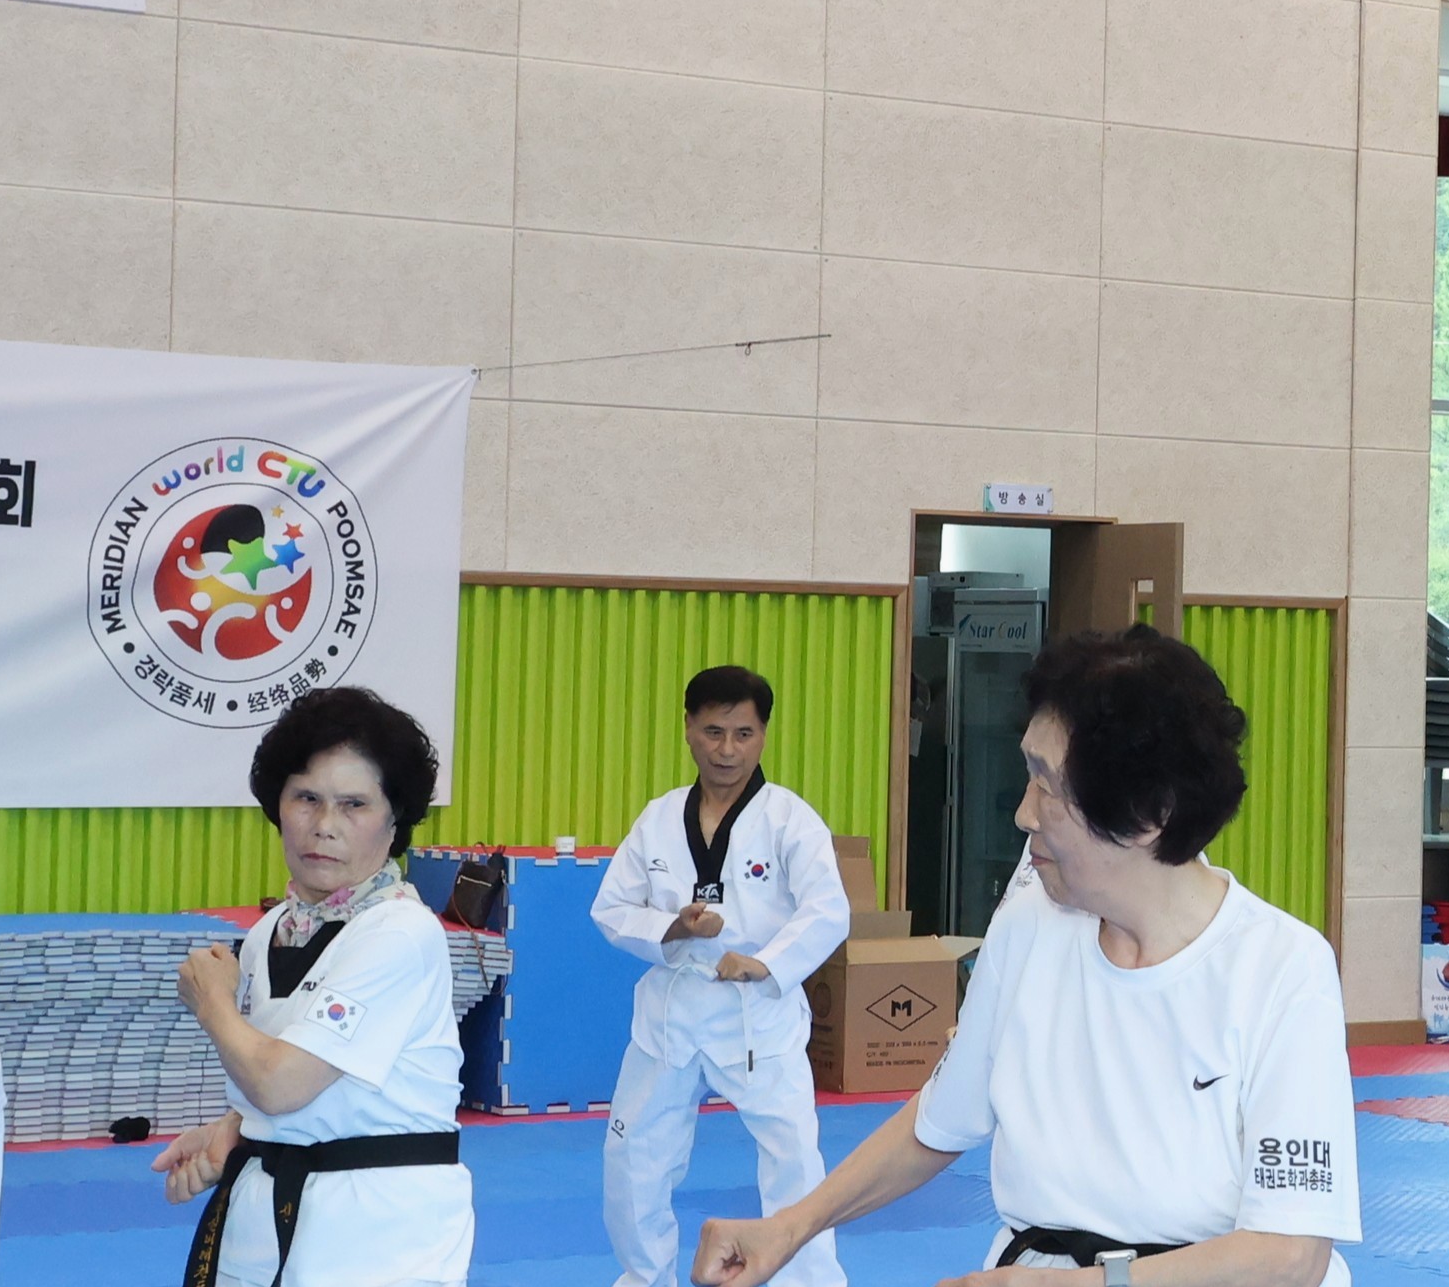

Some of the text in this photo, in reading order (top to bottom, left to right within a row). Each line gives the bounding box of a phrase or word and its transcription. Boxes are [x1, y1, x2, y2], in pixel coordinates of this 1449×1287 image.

[151, 445, 327, 499] world CTU
[100, 495, 150, 636] MERIDIAN
[326, 499, 366, 639] POOMSAE
[134, 653, 217, 716] 경락품세
[697, 883, 720, 900] KTA
[1258, 1137, 1331, 1169] 용인대
